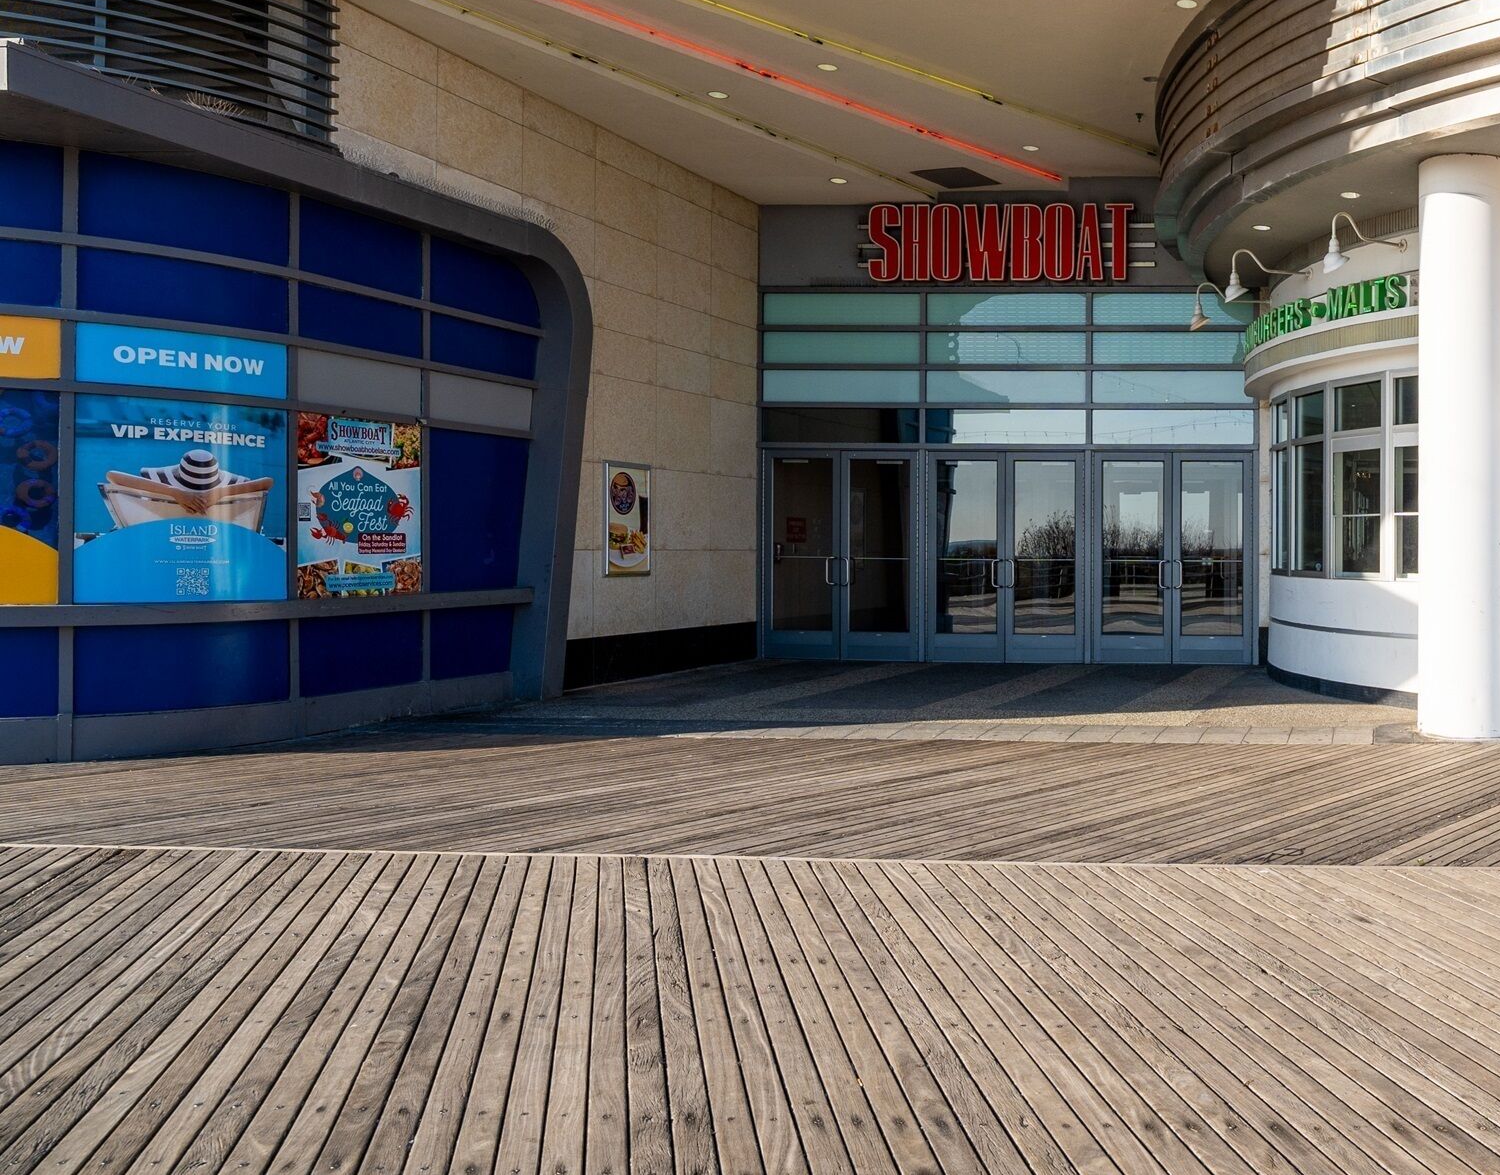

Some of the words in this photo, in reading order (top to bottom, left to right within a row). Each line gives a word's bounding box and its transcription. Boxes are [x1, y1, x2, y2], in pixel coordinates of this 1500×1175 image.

[868, 203, 1134, 281] SHOWBOAT
[1326, 274, 1408, 321] MALTS
[113, 345, 198, 369] OPEN
[204, 354, 264, 376] NOW
[111, 424, 148, 439] VIP
[154, 427, 265, 448] EXPERIENCE
[150, 417, 201, 428] RESERVE
[208, 422, 238, 432] YOUR
[331, 421, 387, 445] SHOWBOAT
[317, 444, 400, 456] www.showboathotelac.com
[328, 481, 339, 491] All
[341, 482, 355, 491] You
[357, 482, 374, 492] Can
[375, 483, 387, 493] Eat
[331, 491, 384, 517] Seafood
[170, 524, 218, 535] ISLAND
[357, 512, 388, 532] Fest
